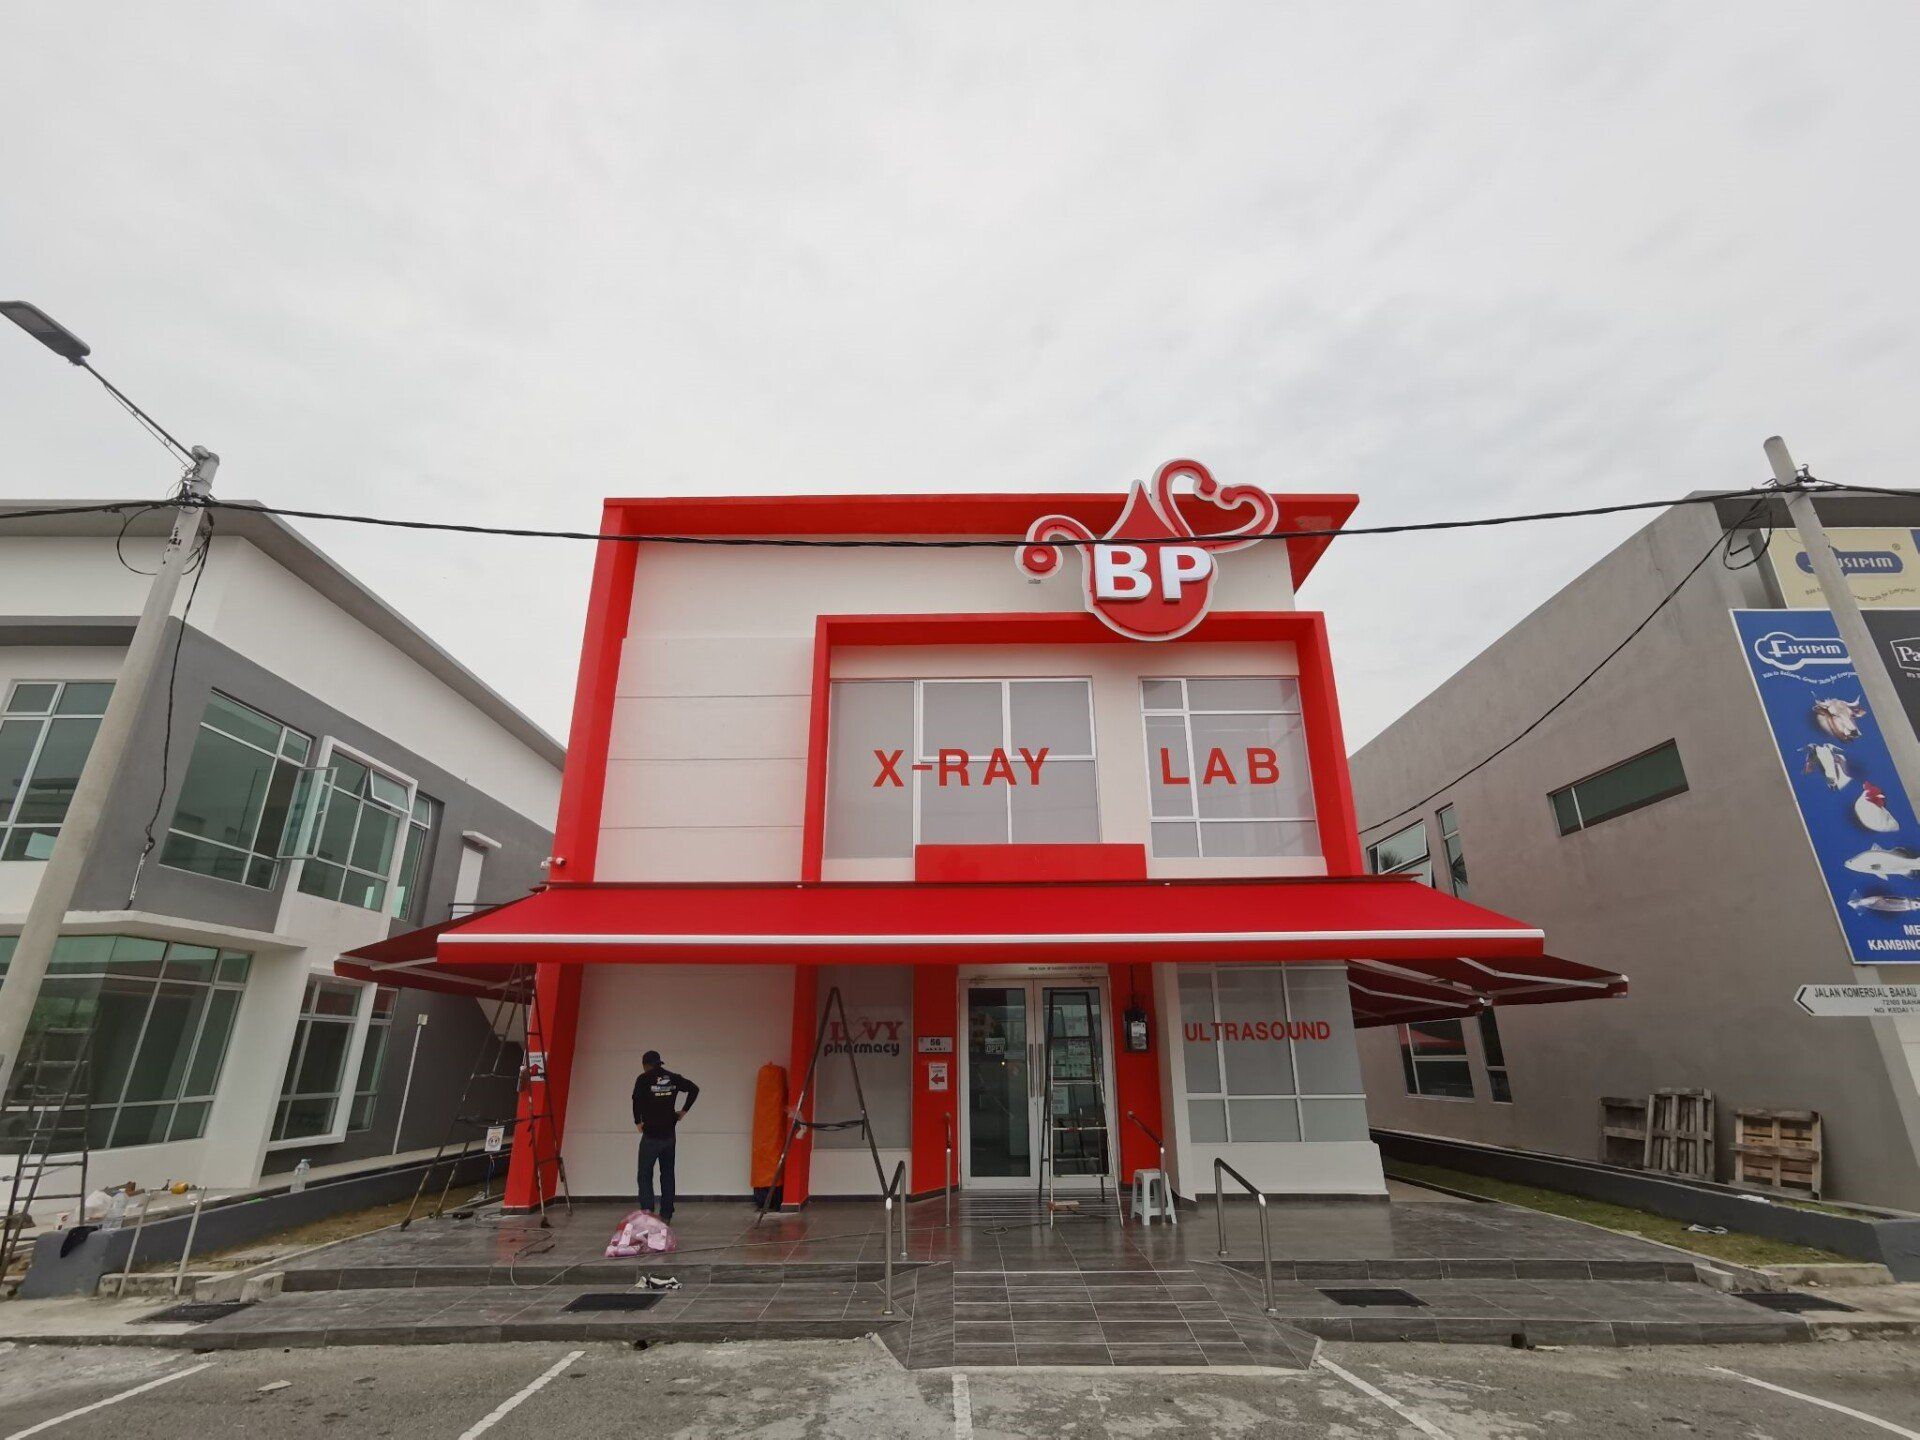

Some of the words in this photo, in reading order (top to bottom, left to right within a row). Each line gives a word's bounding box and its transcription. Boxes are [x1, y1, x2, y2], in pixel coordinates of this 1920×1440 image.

[1094, 543, 1214, 602] BP
[873, 747, 1050, 788] X-RAY
[1160, 747, 1280, 785] LAB
[1814, 987, 1840, 998] JALAN
[1843, 987, 1888, 998] KOMERSIAL
[1889, 987, 1917, 998] BAHAU
[1184, 1021, 1331, 1042] ULTRASOUND
[824, 1042, 900, 1057] pharmacy
